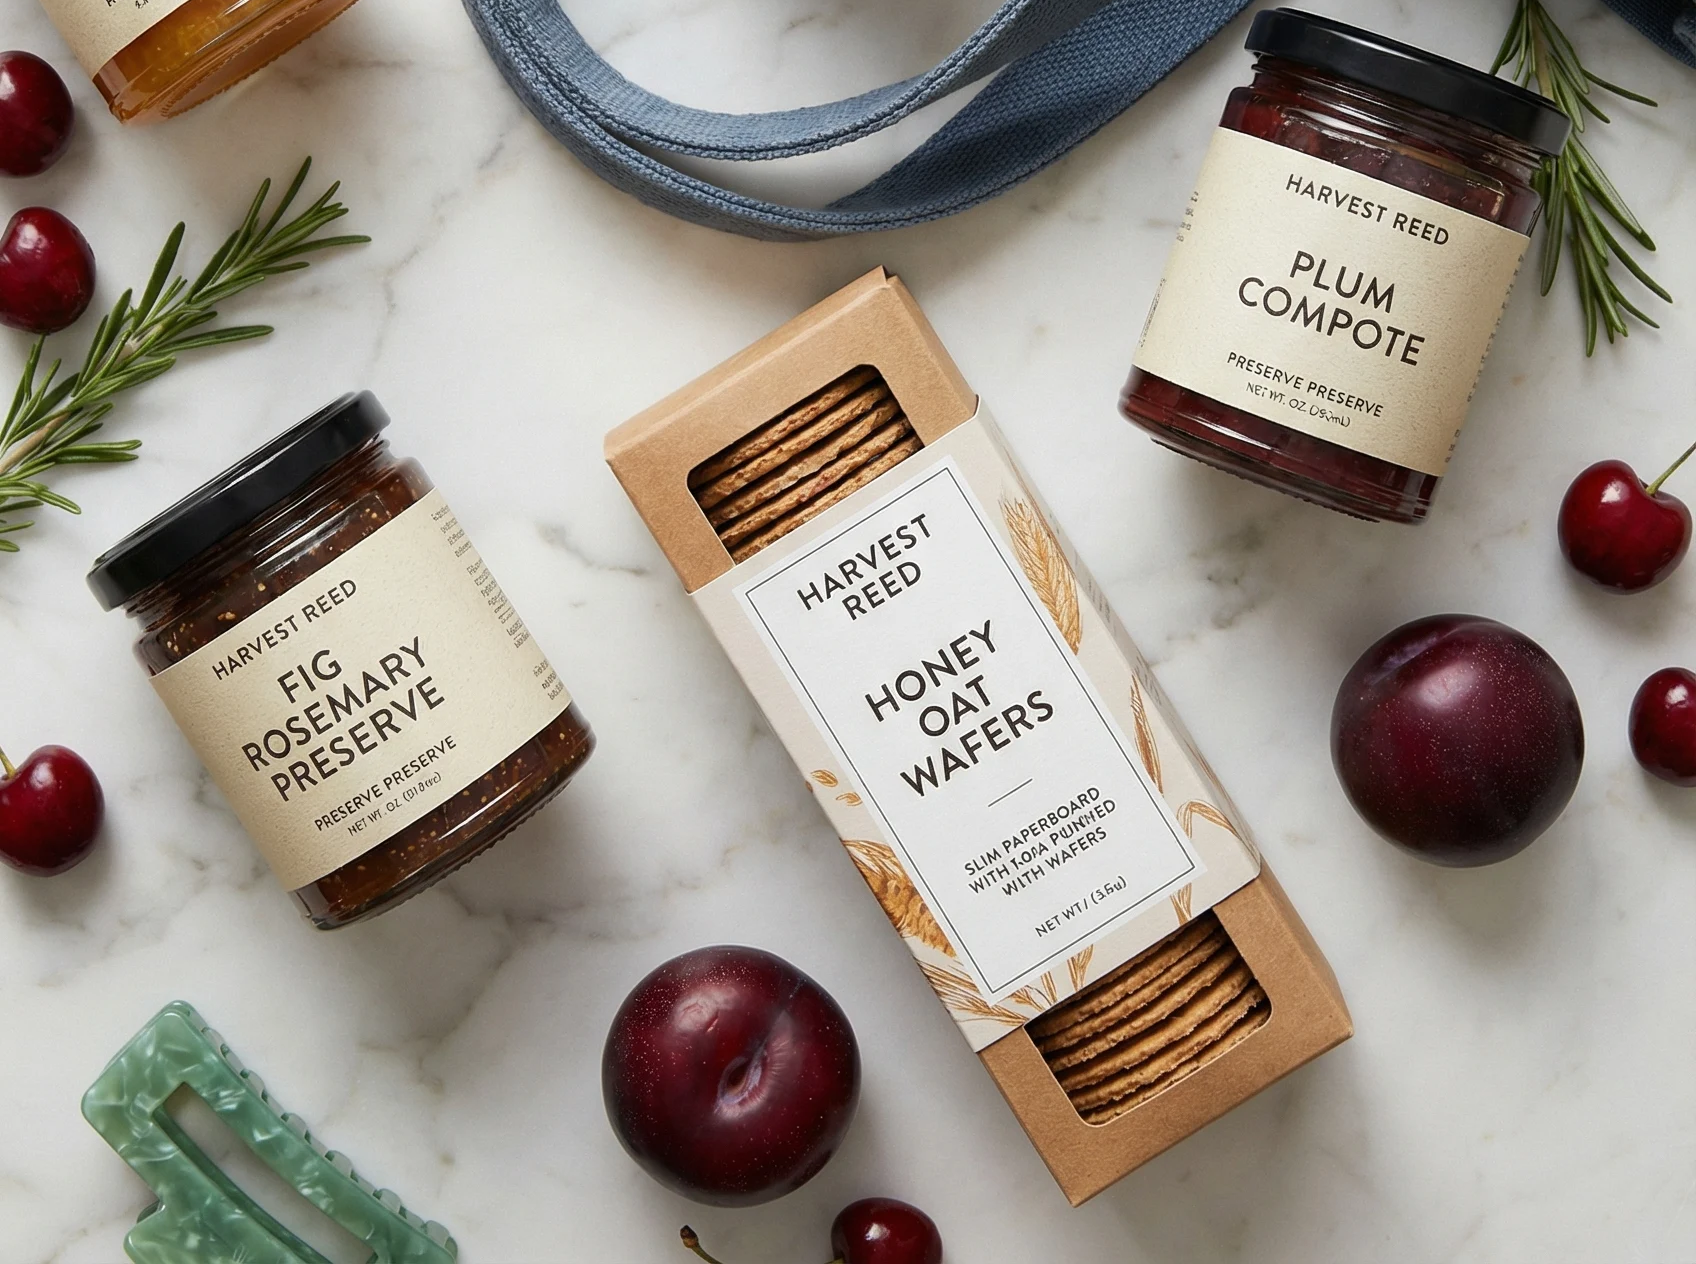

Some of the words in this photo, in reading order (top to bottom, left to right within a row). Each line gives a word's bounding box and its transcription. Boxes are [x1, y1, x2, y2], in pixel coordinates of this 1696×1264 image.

[1285, 173, 1388, 223] HARVEST
[1392, 212, 1449, 246] REED
[1238, 276, 1426, 367] COMPOTE
[1289, 250, 1395, 314] PLUM
[1227, 351, 1305, 390] PRESERVE
[1306, 381, 1384, 418] PRESERVE
[796, 513, 931, 611] HARVEST
[841, 561, 922, 621] REED
[211, 614, 299, 681] HARVEST
[301, 579, 357, 623] REED
[240, 635, 426, 773] ROSEMARY
[276, 649, 343, 704] FIG
[864, 619, 996, 723] HONEY
[918, 674, 991, 737] OAT
[270, 675, 446, 803] PRESERVE
[899, 690, 1054, 797] WAFERS
[314, 784, 384, 832] PRESERVE
[382, 735, 457, 791] PRESERVE
[964, 847, 1002, 876] SLIM
[1001, 787, 1100, 854] PAPERBOARD
[1001, 864, 1046, 896] WITH
[1044, 826, 1107, 870] WAFERS
[968, 863, 1011, 894] WITH
[1034, 914, 1061, 938] NET
